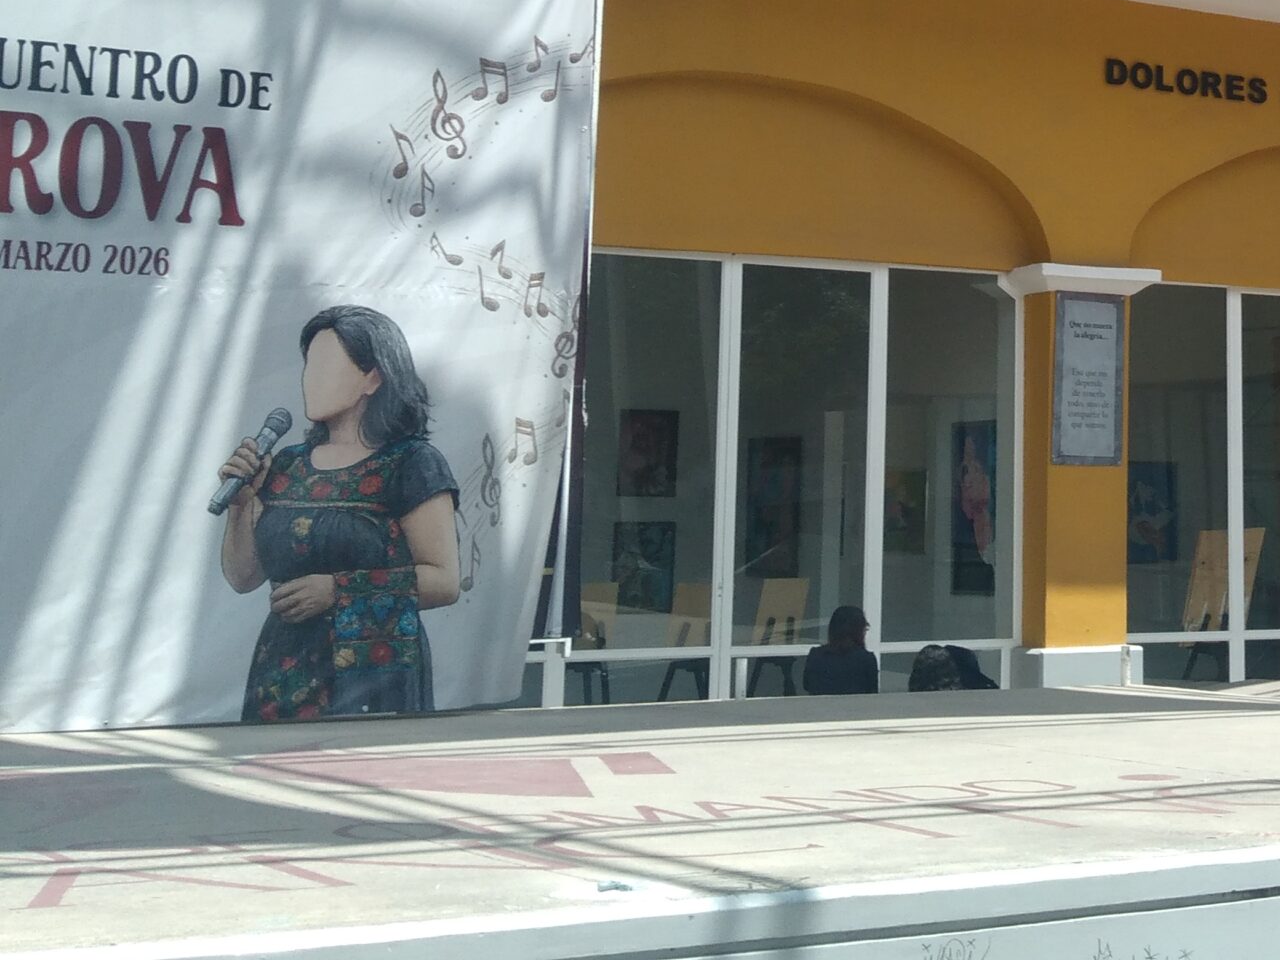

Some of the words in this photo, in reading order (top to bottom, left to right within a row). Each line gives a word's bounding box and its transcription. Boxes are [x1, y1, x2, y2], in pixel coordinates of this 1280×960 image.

[0, 37, 198, 104] UENTRO
[217, 68, 274, 111] DE
[1104, 57, 1269, 105] DOLORES
[0, 110, 246, 227] ROVA
[102, 243, 170, 277] 2026
